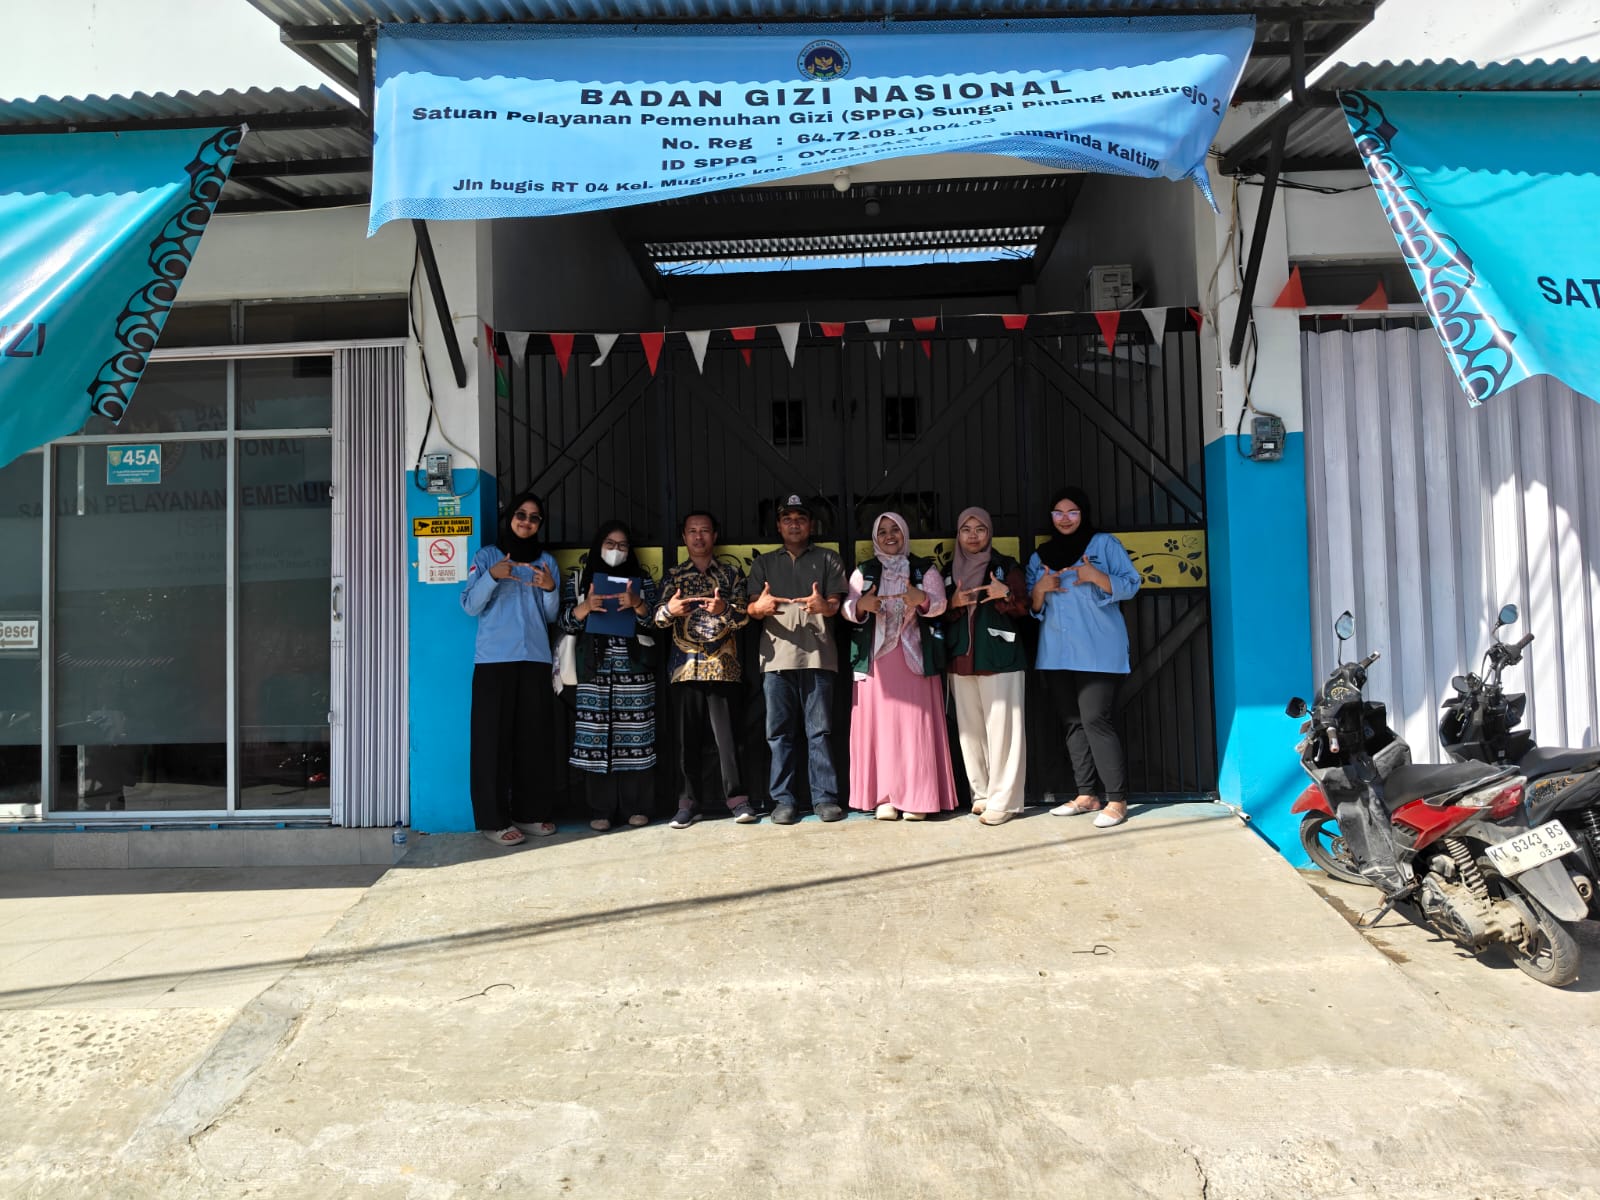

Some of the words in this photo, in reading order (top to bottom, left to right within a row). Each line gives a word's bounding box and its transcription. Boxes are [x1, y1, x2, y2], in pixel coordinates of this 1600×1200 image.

[412, 106, 497, 121] Satuan
[506, 111, 632, 128] Pelayanan
[640, 113, 780, 127] Pemenuhan
[789, 110, 833, 124] Gizi
[841, 107, 924, 124] (SPPG)
[932, 102, 1014, 117] Sungai
[1022, 93, 1106, 109] Pinang
[1111, 84, 1208, 105] Mugirejo
[1211, 98, 1221, 116] 2
[580, 88, 722, 107] BADAN
[745, 87, 830, 107] GIZI
[855, 79, 1072, 104] NASIONAL
[662, 137, 699, 150] No.
[708, 136, 753, 150] Reg
[797, 117, 997, 144] 64.72.08.1004.03
[453, 179, 483, 191] Jln
[490, 179, 545, 194] bugis
[551, 181, 579, 193] RT
[585, 182, 609, 193] 04
[616, 180, 653, 191] Kel.
[1107, 141, 1160, 171] Kaltim
[661, 159, 685, 171] ID
[694, 155, 757, 169] SPPG
[1537, 276, 1600, 309] SAT
[122, 449, 160, 466] 45A
[456, 525, 470, 533] JAM
[1490, 846, 1509, 862] KT
[1511, 832, 1543, 853] 6343
[1545, 824, 1564, 839] BS
